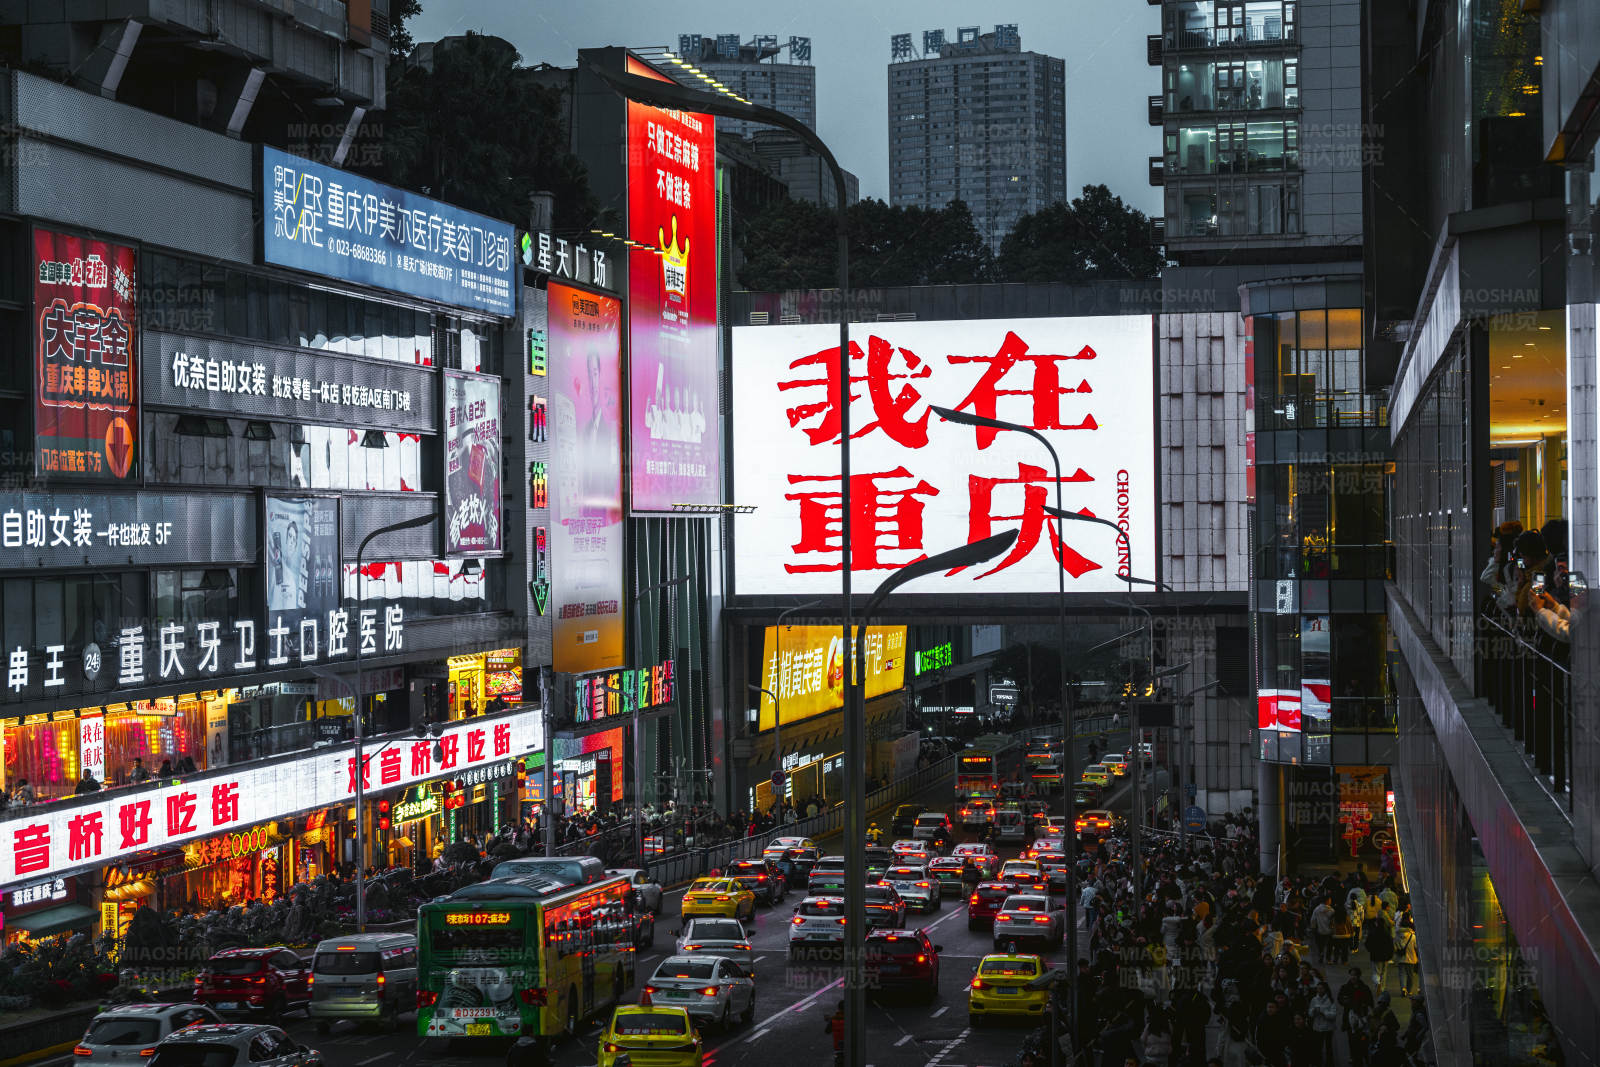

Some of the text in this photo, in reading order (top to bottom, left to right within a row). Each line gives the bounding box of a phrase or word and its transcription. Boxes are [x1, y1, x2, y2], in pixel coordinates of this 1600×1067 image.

[680, 34, 811, 61] 朗晴广场
[647, 120, 700, 173] 只做正宗麻辣
[328, 182, 510, 272] 重庆伊美尔医疗美容门诊部
[538, 232, 606, 288] 星天广场
[46, 363, 128, 399] 重庆串串火锅
[172, 352, 411, 411] 优奈自助女装 批发零售一体店 好吃街A区南门5楼
[777, 331, 1098, 450] 我在
[41, 447, 102, 472] 门店位置在下方
[2, 508, 172, 547] 自助女装 一件也批发 5F
[784, 462, 1103, 580] 重庆
[1116, 468, 1130, 577] CHONGQING
[8, 645, 65, 692] 串王
[118, 603, 404, 684] 重庆牙卫士口腔医院
[82, 721, 103, 745] 我在
[82, 746, 103, 768] 重庆
[347, 723, 511, 793] 观音桥好吃街
[13, 782, 240, 876] 音桥好吃街
